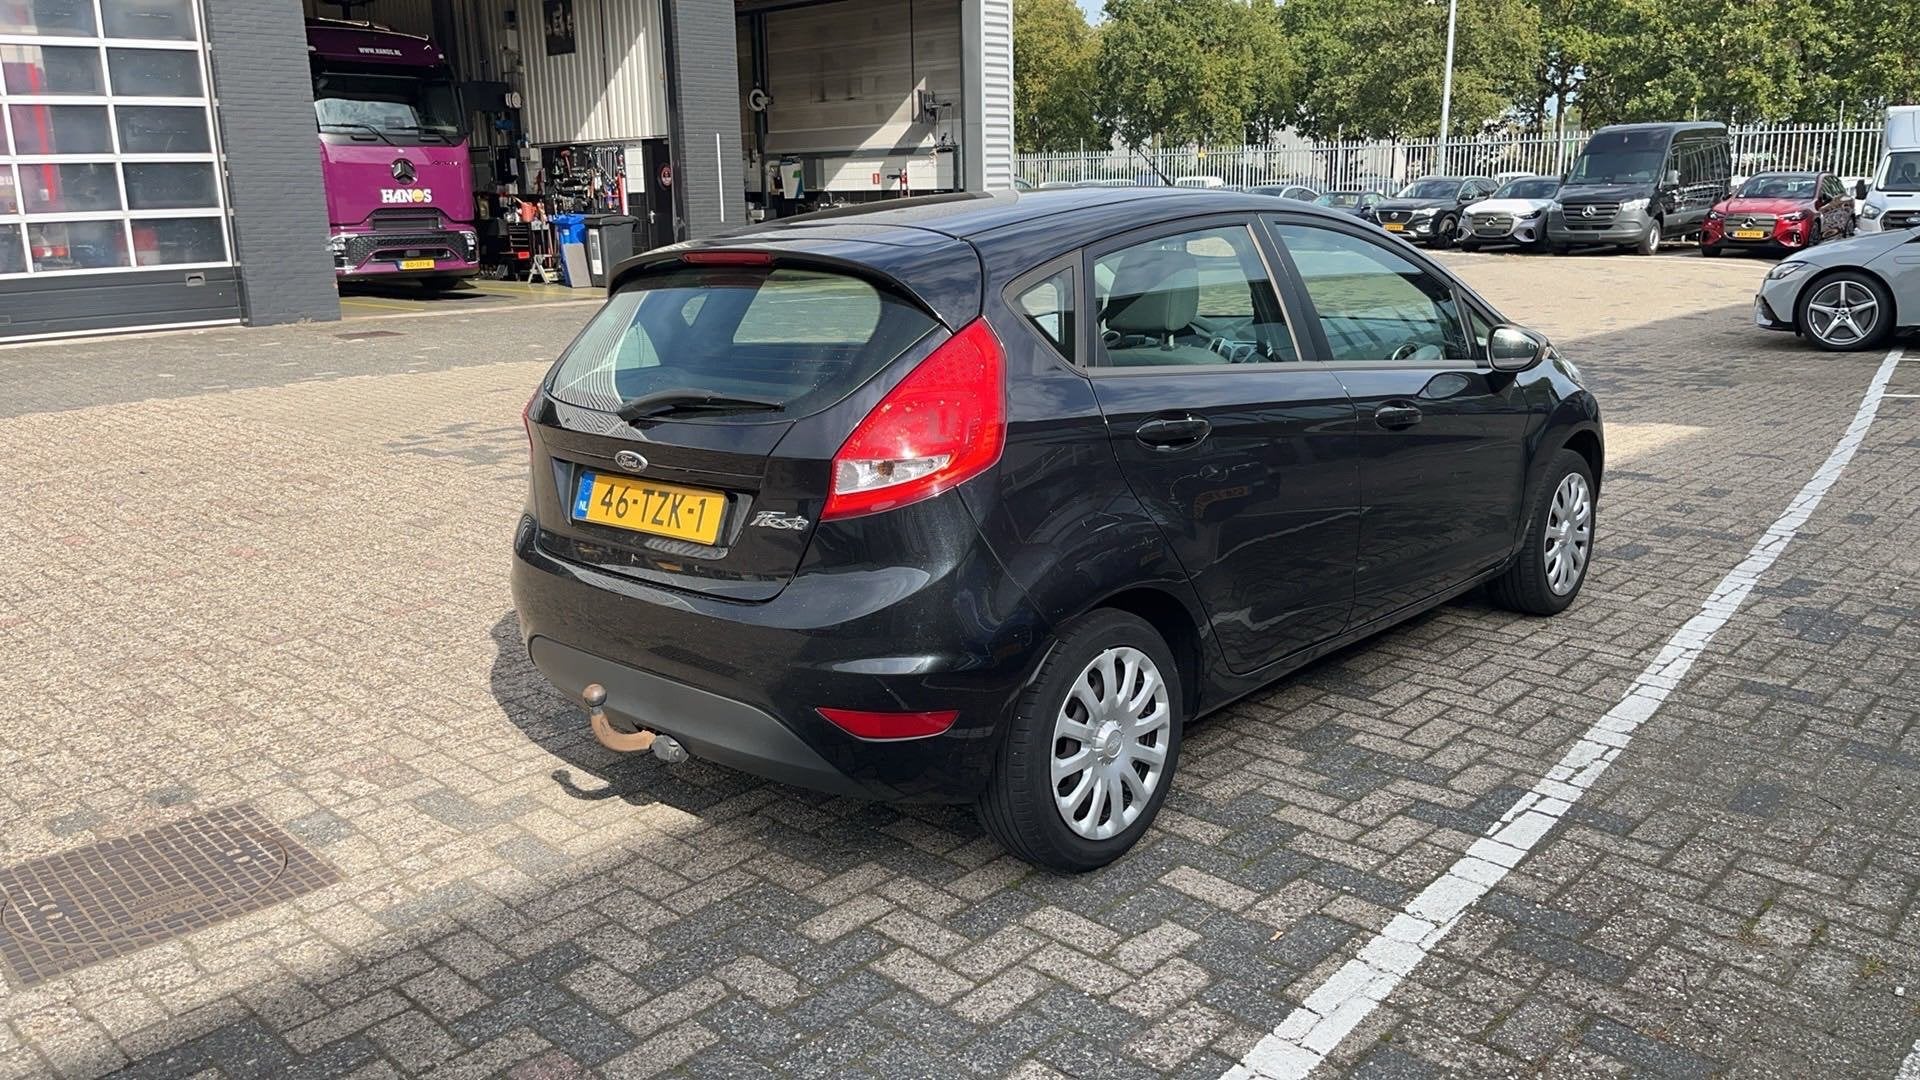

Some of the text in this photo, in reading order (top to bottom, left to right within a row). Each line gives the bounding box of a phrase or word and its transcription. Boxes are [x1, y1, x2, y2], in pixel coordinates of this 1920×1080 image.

[381, 188, 432, 203] HANOS
[620, 454, 641, 469] Ford
[578, 500, 588, 511] NL
[600, 483, 707, 533] 46-TZK-1
[750, 511, 809, 530] Fiesta
